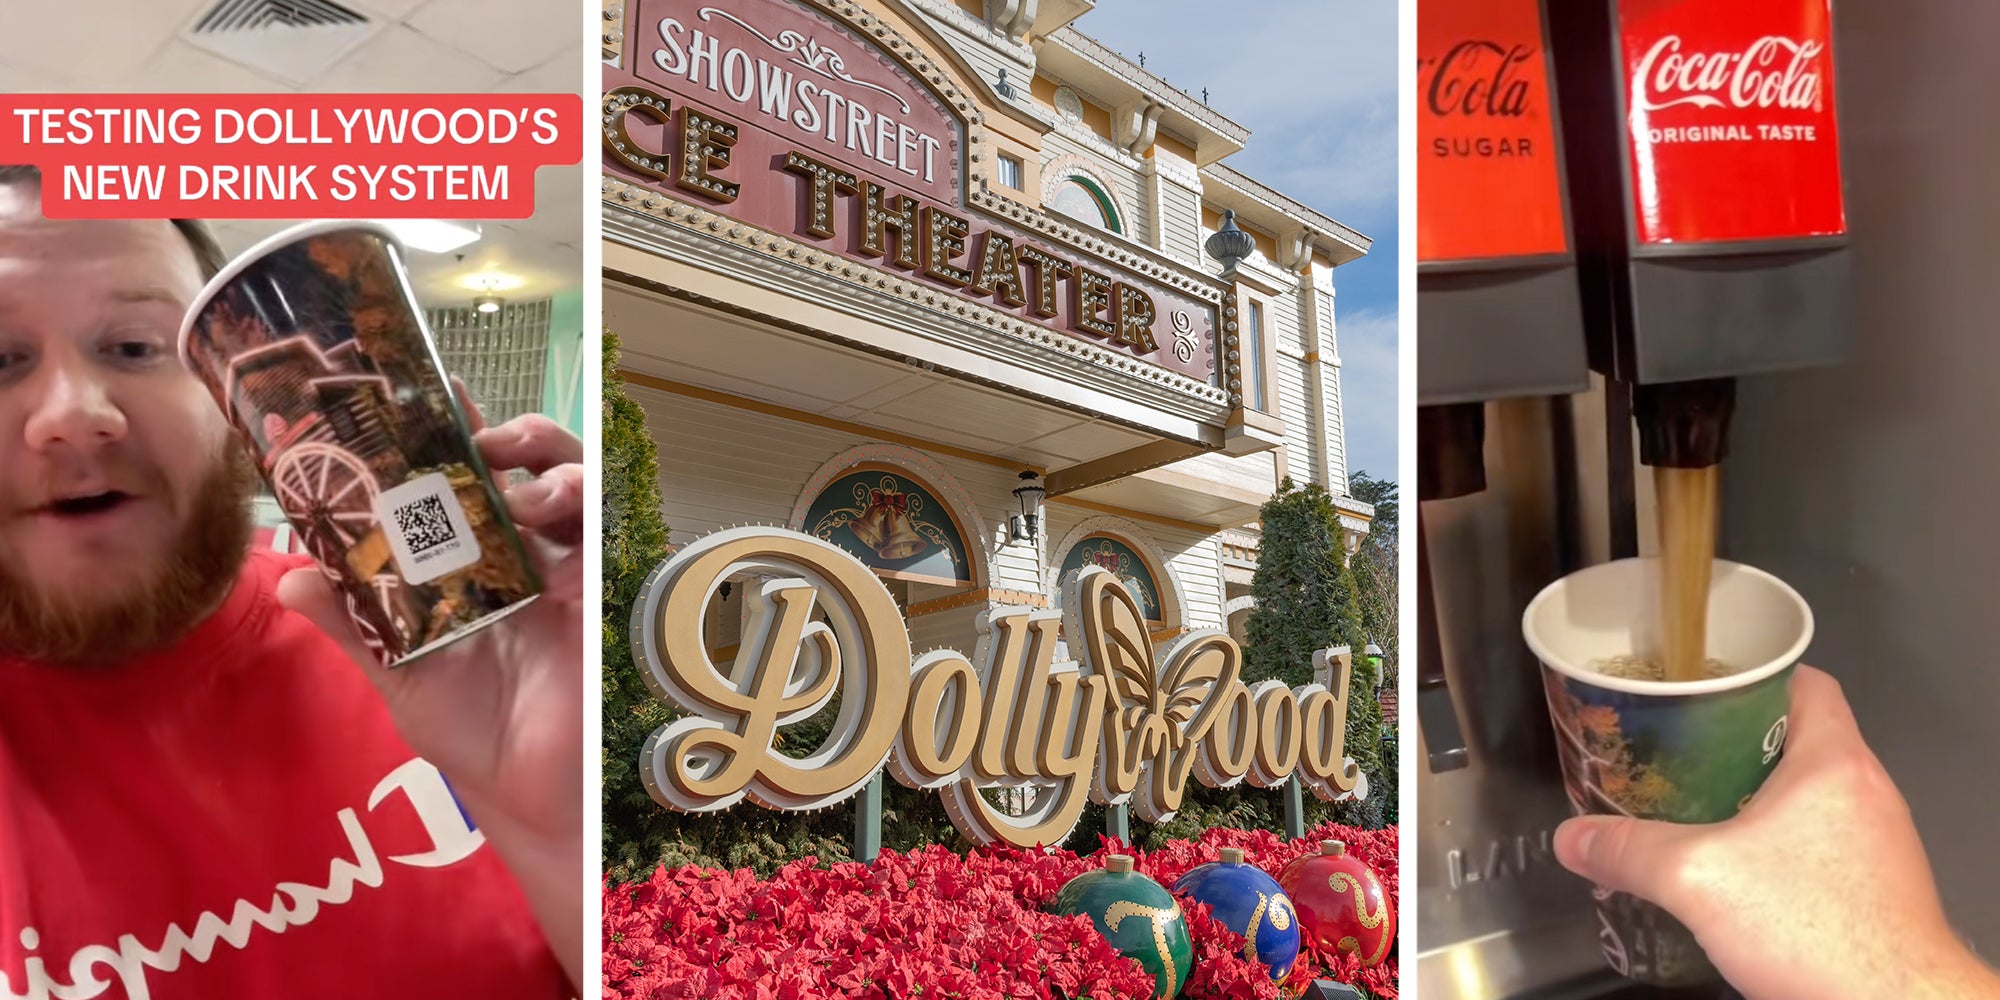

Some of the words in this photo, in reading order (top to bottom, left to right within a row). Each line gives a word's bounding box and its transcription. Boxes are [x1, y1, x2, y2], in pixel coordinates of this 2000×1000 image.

[652, 17, 942, 184] SHOWSTREET
[1631, 35, 1824, 112] Coca-Cola
[1433, 137, 1533, 158] SUGAR
[1650, 125, 1753, 144] ORIGINAL
[1757, 124, 1817, 142] TASTE
[783, 150, 1159, 355] THEATER
